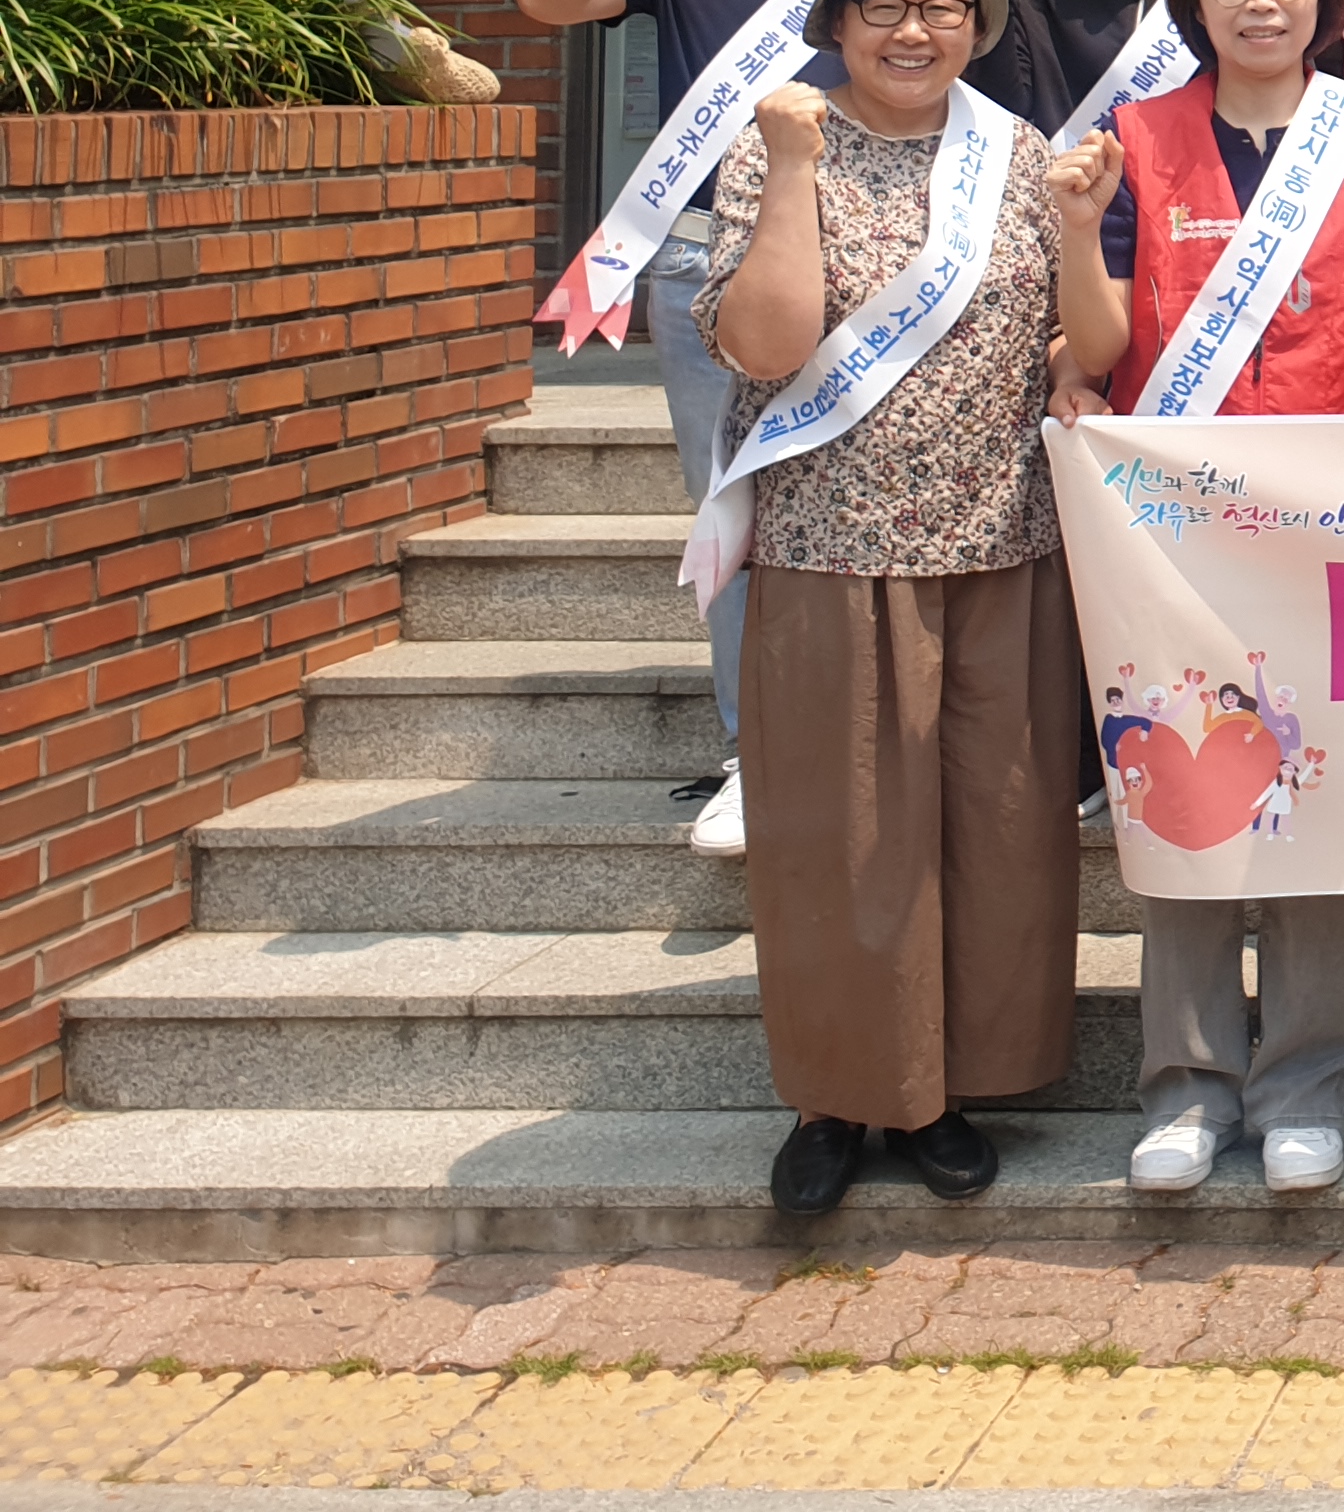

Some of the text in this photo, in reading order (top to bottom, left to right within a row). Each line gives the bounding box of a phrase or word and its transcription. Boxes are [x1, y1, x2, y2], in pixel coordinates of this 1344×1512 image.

[735, 30, 788, 86] 함께
[640, 81, 739, 210] 찾아주세요
[951, 128, 990, 205] 안산시
[1103, 457, 1187, 504] 시민과
[1129, 502, 1213, 541] 자유로운
[1222, 502, 1310, 538] 혁신도시
